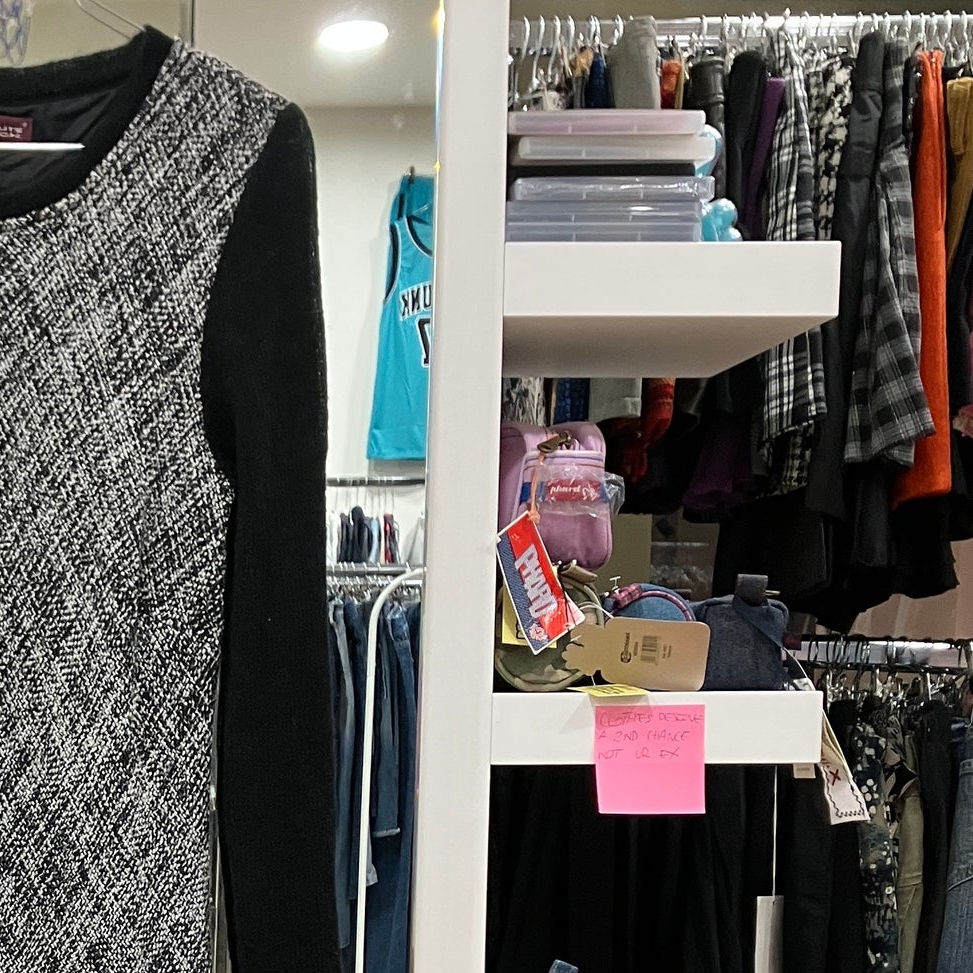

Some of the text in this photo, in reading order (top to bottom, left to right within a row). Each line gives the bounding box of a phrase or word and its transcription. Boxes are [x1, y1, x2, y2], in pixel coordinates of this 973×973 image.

[550, 484, 582, 495] phard
[514, 543, 558, 619] PHARD
[598, 748, 625, 760] NOT
[660, 746, 681, 760] EX
